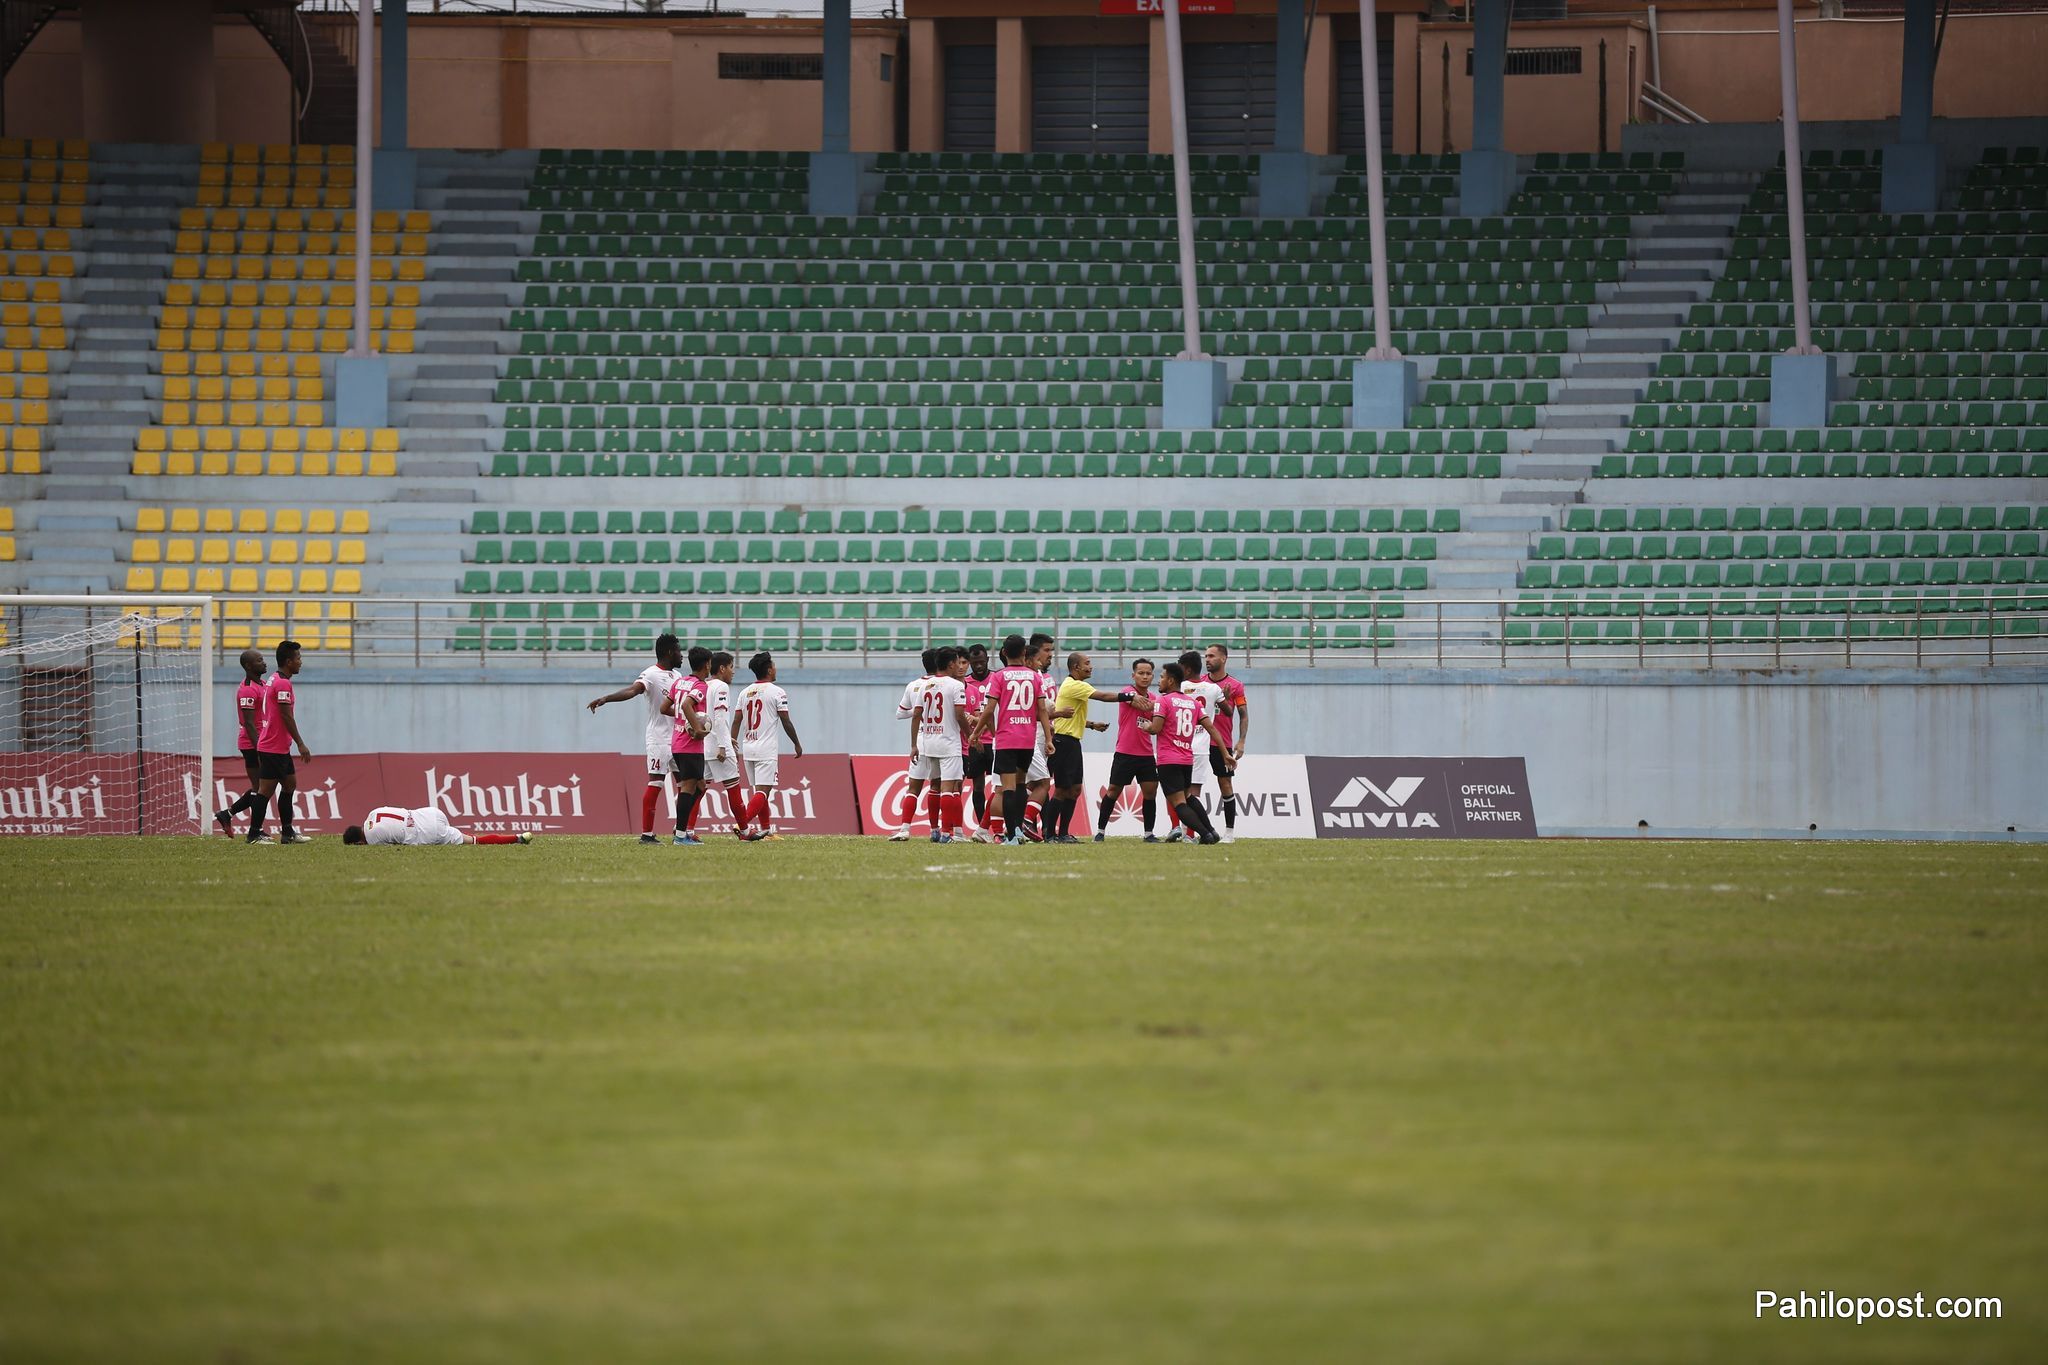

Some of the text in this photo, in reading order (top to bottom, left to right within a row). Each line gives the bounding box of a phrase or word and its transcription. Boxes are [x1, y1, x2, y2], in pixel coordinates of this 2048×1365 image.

[1007, 681, 1034, 710] 20
[747, 699, 763, 731] 13
[924, 692, 943, 724] 23
[1176, 708, 1193, 738] 18
[651, 759, 660, 770] 24
[425, 766, 585, 818] Khukri
[1461, 784, 1515, 796] OFFICIAL
[1203, 792, 1301, 817] UAWEI
[1464, 798, 1496, 809] BALL
[1322, 812, 1440, 828] NIVIA
[1466, 811, 1522, 822] PARTNER
[0, 824, 64, 833] XX RUM
[474, 822, 543, 831] XXX RUM
